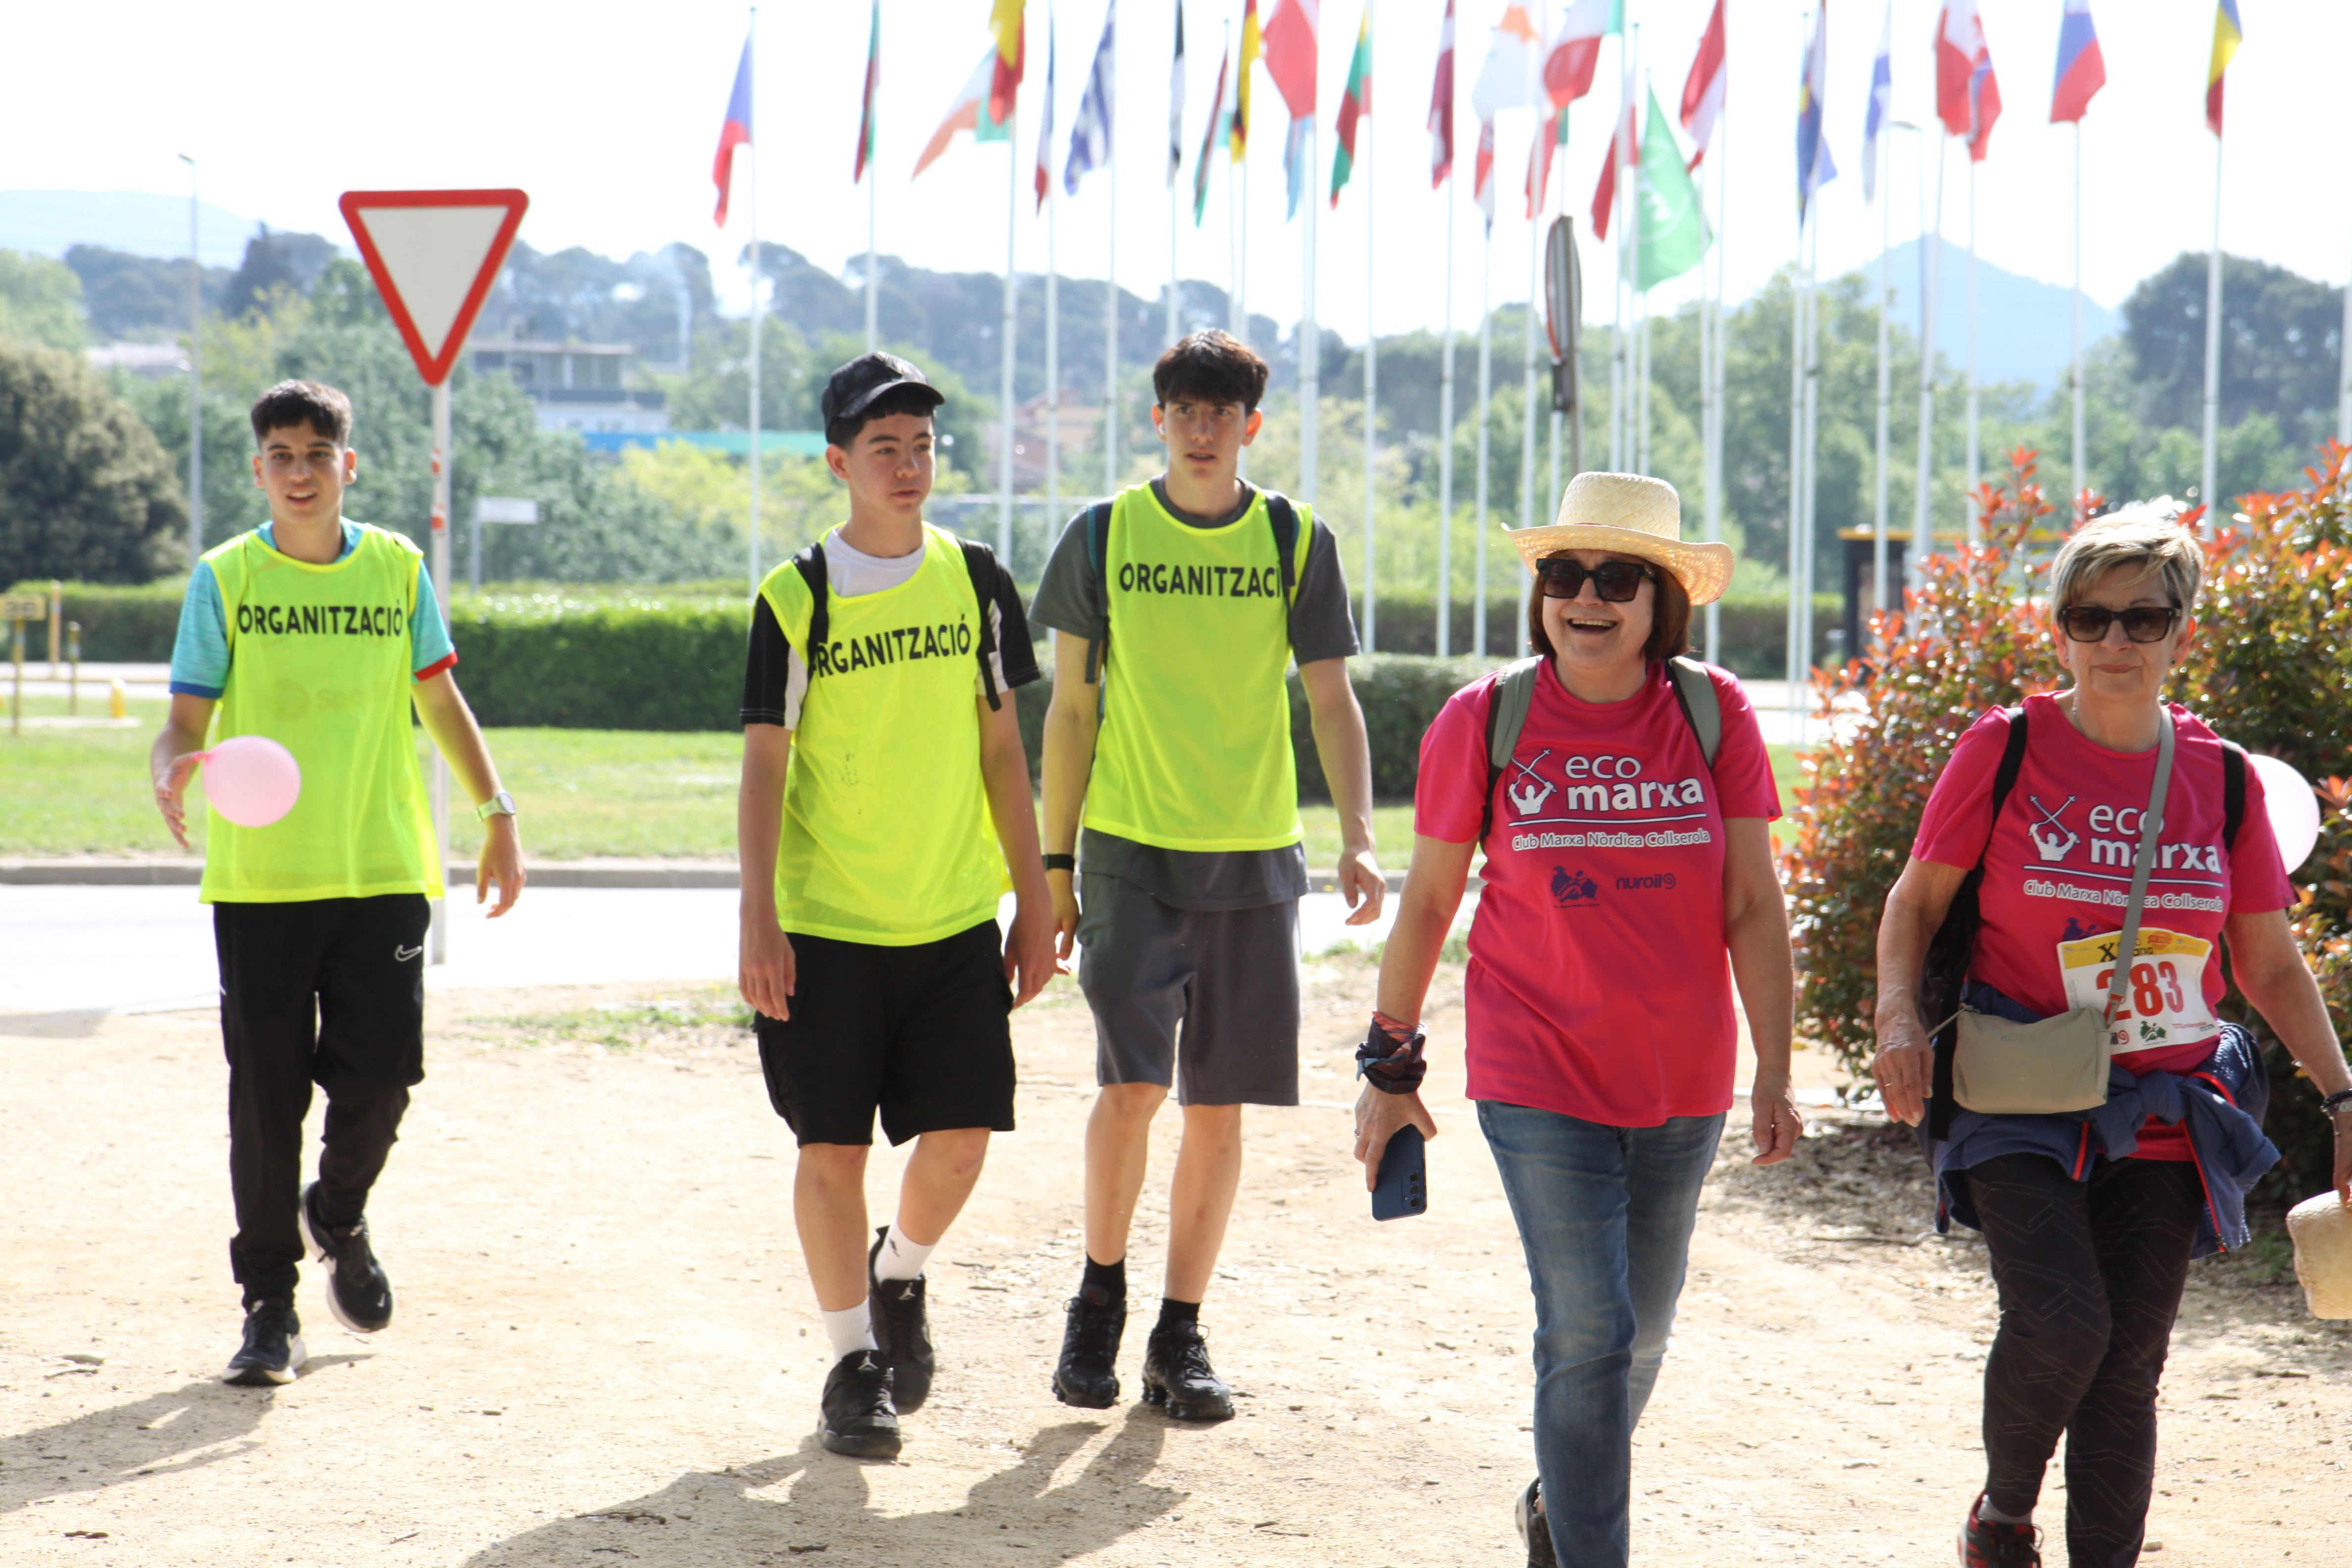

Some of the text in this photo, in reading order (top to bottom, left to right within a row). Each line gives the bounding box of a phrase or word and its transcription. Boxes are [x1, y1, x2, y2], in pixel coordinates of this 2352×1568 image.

[1120, 560, 1281, 597] ORGANITZACI
[237, 599, 403, 637] ORGANITZACIÓ
[812, 614, 971, 678] RGANITZACIÓ
[1565, 755, 1641, 779] eco
[1568, 778, 1704, 811] marxa
[1513, 828, 1710, 850] Club Marxa Nòrdica Collserola
[2024, 881, 2222, 912] Club Marxa Nòrca Collserola
[2098, 942, 2117, 962] X
